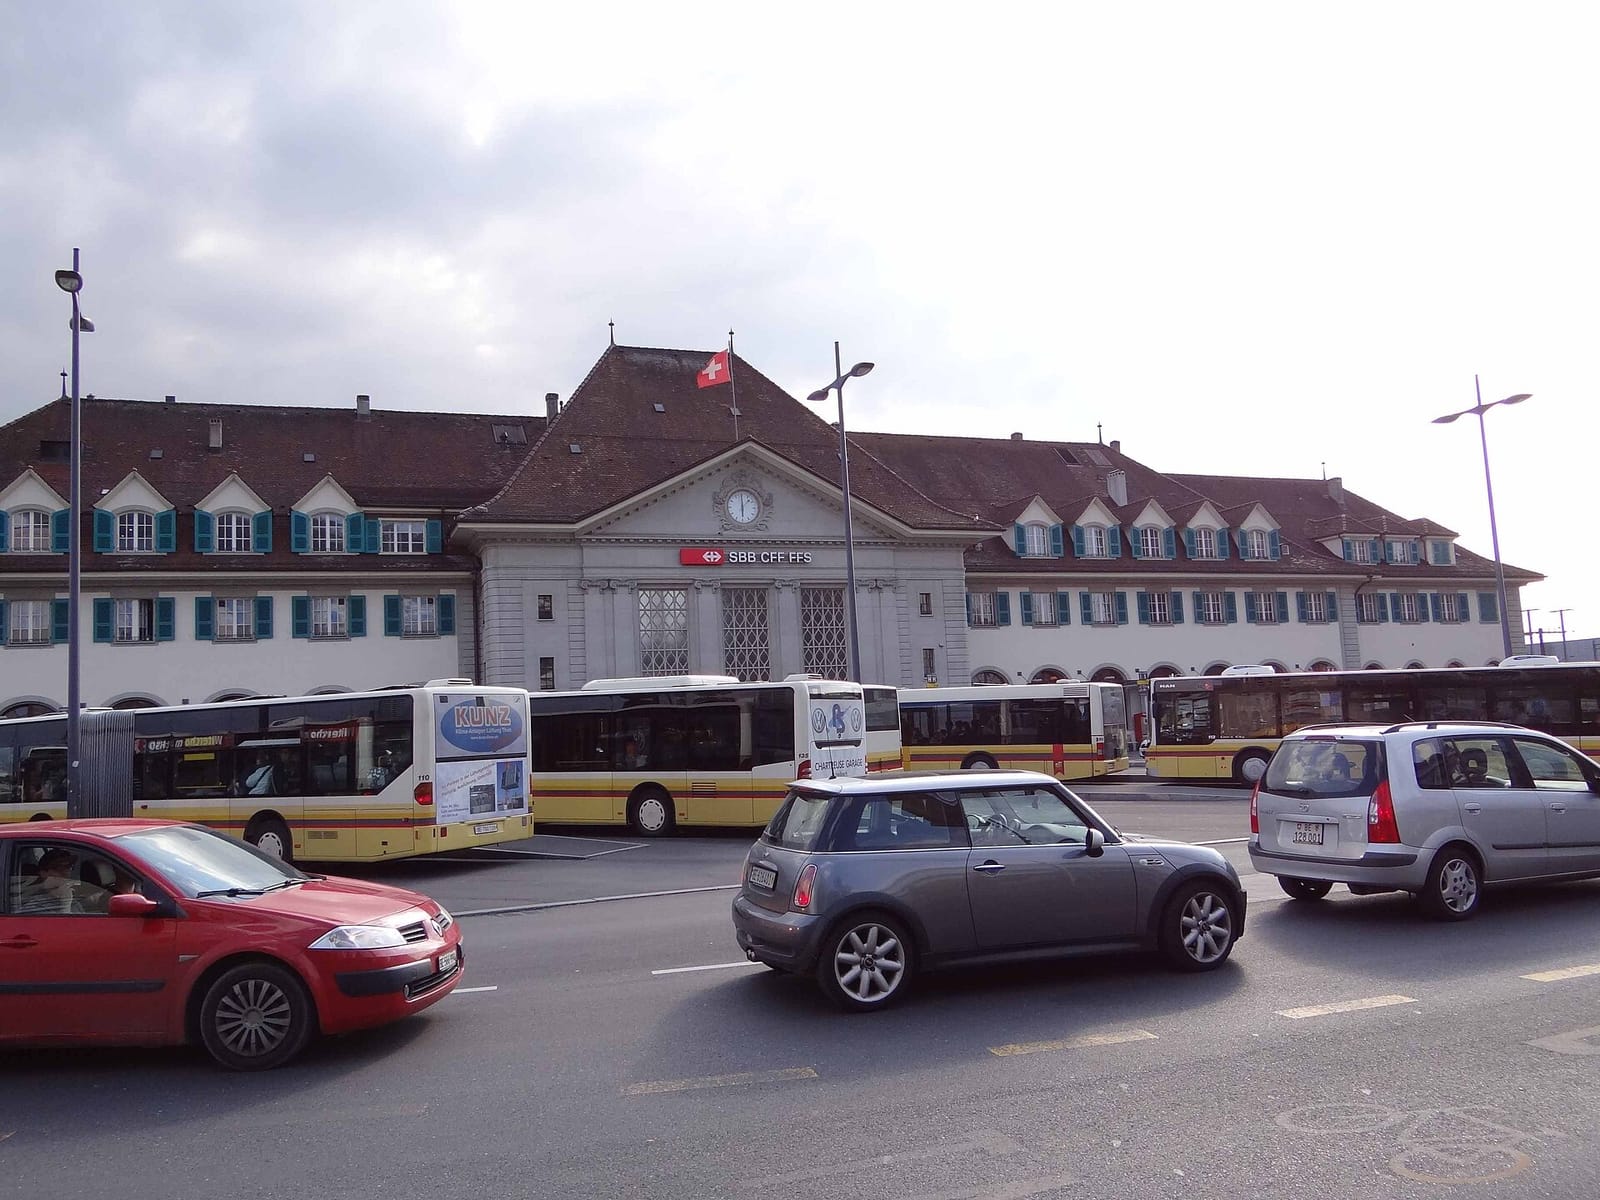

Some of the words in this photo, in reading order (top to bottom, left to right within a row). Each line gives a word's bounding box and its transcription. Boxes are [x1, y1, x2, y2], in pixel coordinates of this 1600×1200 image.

[729, 551, 756, 563] SBB
[760, 551, 785, 563] CFF
[789, 551, 812, 563] FFS
[454, 705, 511, 727] KUNZ
[845, 758, 863, 768] GARAGE
